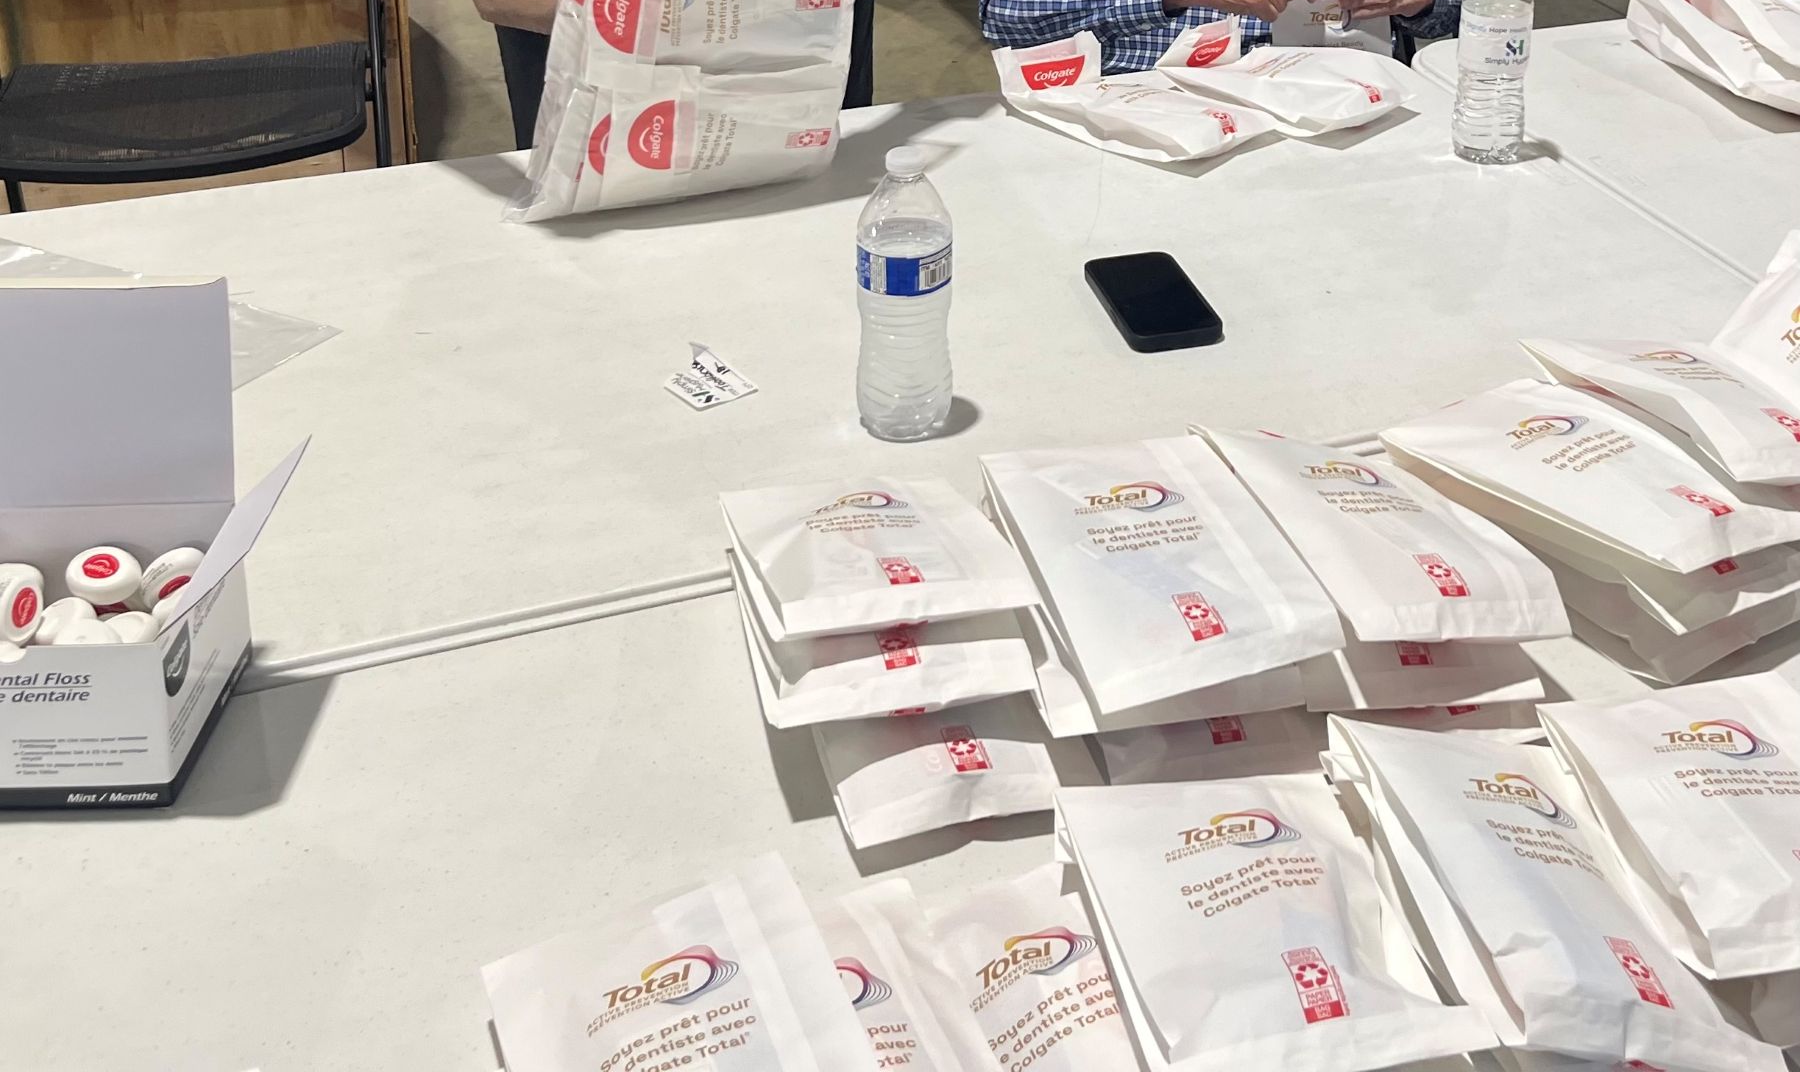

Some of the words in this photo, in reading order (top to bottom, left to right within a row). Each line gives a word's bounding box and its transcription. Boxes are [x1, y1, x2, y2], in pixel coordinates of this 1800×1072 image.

[1310, 11, 1344, 23] Total
[1485, 57, 1510, 65] Simply
[1034, 67, 1077, 82] Colgate
[649, 115, 665, 160] Colgate
[1506, 421, 1556, 440] Total
[1542, 442, 1574, 465] Soyez
[1576, 435, 1596, 449] prêt
[1596, 429, 1617, 441] pour
[1555, 460, 1569, 471] le
[1569, 441, 1607, 463] dentiste
[1608, 434, 1631, 446] avec
[1572, 451, 1612, 473] Colgate
[1611, 441, 1637, 455] Total
[1304, 465, 1363, 477] Total
[815, 494, 873, 514] Total
[1084, 489, 1147, 507] Total
[1341, 496, 1393, 505] dentiste
[1340, 505, 1389, 514] Colgate
[1087, 525, 1129, 536] Soyez
[1133, 520, 1162, 531] prêt
[1165, 515, 1198, 527] pour
[1092, 537, 1106, 545] le
[1109, 529, 1169, 543] dentiste
[1171, 524, 1204, 532] avec
[1106, 539, 1161, 553] Colgate
[43, 673, 92, 685] Floss
[12, 689, 90, 703] dentaire
[1661, 731, 1734, 744] Total
[1674, 768, 1723, 779] Soyez
[1726, 768, 1760, 776] prêt
[1763, 769, 1799, 777] pour
[1683, 780, 1699, 789] le
[1703, 776, 1769, 785] dentiste
[67, 793, 97, 803] Mint
[108, 791, 158, 802] Menthe
[1469, 778, 1539, 800] Total
[1700, 787, 1764, 797] Colgate
[1764, 787, 1800, 795] Tota
[1178, 819, 1255, 845] Total
[1486, 818, 1532, 835] Soyez
[1496, 832, 1512, 842] le
[1515, 835, 1578, 856] dentiste
[1514, 846, 1573, 866] Colgate
[1180, 871, 1234, 897] Soyez
[1237, 856, 1274, 880] prêt
[1277, 855, 1317, 867] pour
[1187, 899, 1205, 911] le
[1208, 868, 1280, 902] dentiste
[1284, 866, 1325, 876] avec
[1203, 885, 1271, 919] Colgate
[1271, 877, 1317, 890] Total
[976, 941, 1051, 989] Total
[998, 956, 1053, 986] PREVENTION
[1024, 959, 1054, 977] ACTIVE
[603, 963, 691, 1009] Total
[653, 987, 690, 1004] ACTIVE
[586, 1006, 621, 1032] ACTIVE
[624, 981, 689, 1009] PREVENTION
[1037, 987, 1072, 1015] prêt
[867, 1022, 908, 1038] pour
[1013, 1002, 1081, 1053] dentiste
[1085, 990, 1115, 1007] ave
[600, 1033, 655, 1071] Soyez
[660, 1013, 701, 1039] prêt
[706, 997, 751, 1022] pour
[625, 1031, 706, 1072] dentiste
[711, 1015, 756, 1035] avec
[1010, 1027, 1073, 1072] Colgate
[1073, 1005, 1120, 1029] Total
[695, 1034, 747, 1059] Total
[874, 1039, 917, 1050] avec
